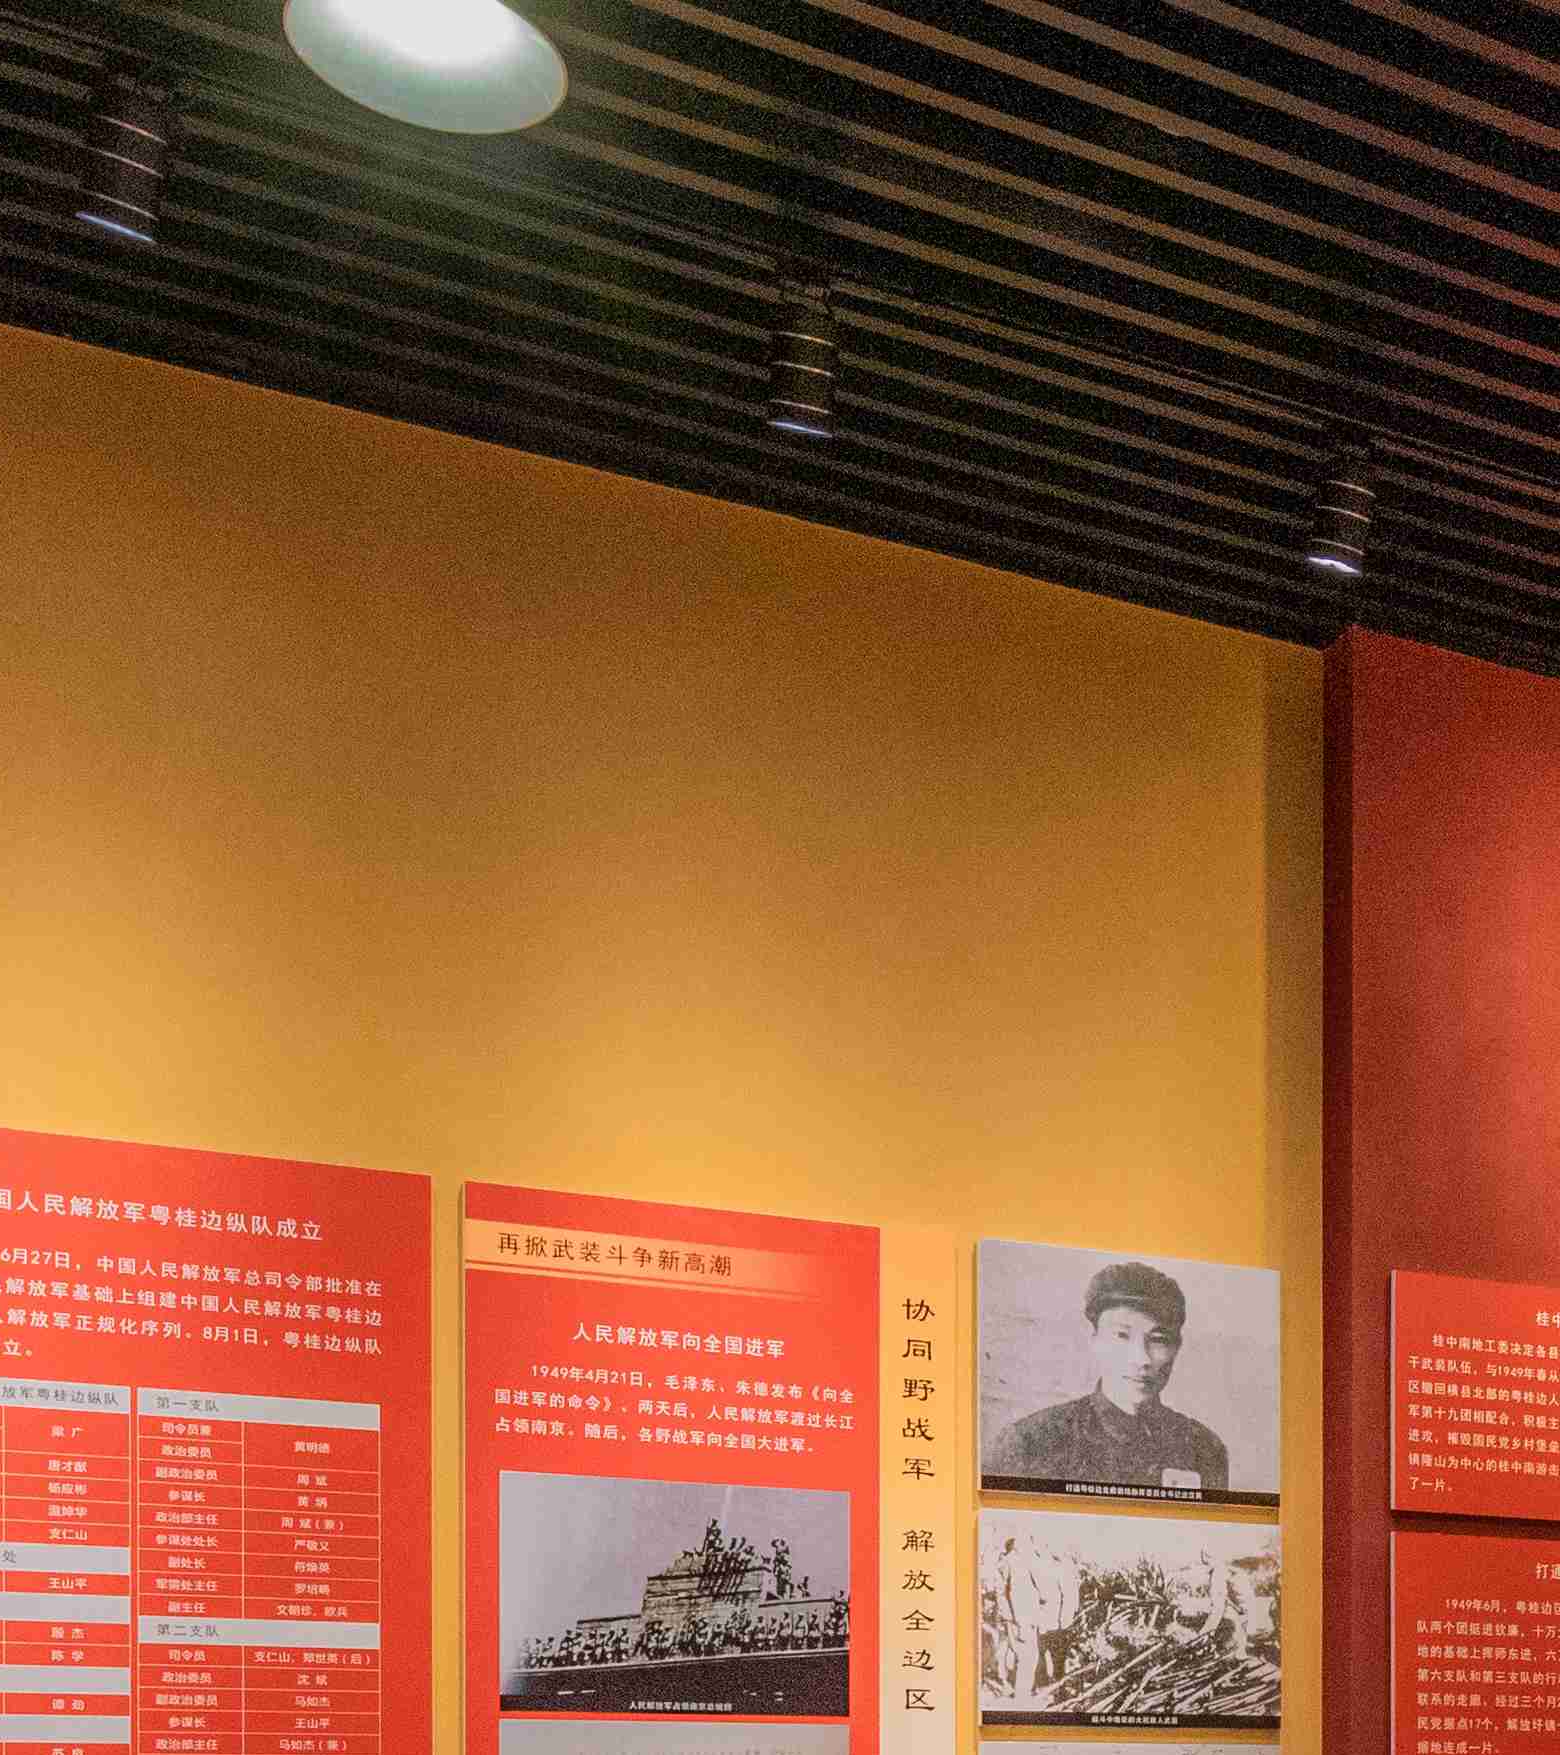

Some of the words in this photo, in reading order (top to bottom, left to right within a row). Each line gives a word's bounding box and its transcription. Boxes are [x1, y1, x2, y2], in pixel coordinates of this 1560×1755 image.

[497, 1231, 732, 1277] 再掀武装斗争新高潮
[572, 1321, 785, 1360] 人民解放军向全国进军
[902, 1297, 936, 1481] 协同野战军
[156, 1396, 218, 1412] 第一支队
[161, 1444, 211, 1459] 政治委员
[155, 1510, 217, 1526] 政治部主任
[902, 1529, 936, 1711] 解放全边区
[157, 1623, 219, 1637] 第二支队
[161, 1670, 211, 1683] 政治委员
[155, 1738, 217, 1750] 政治部主任
